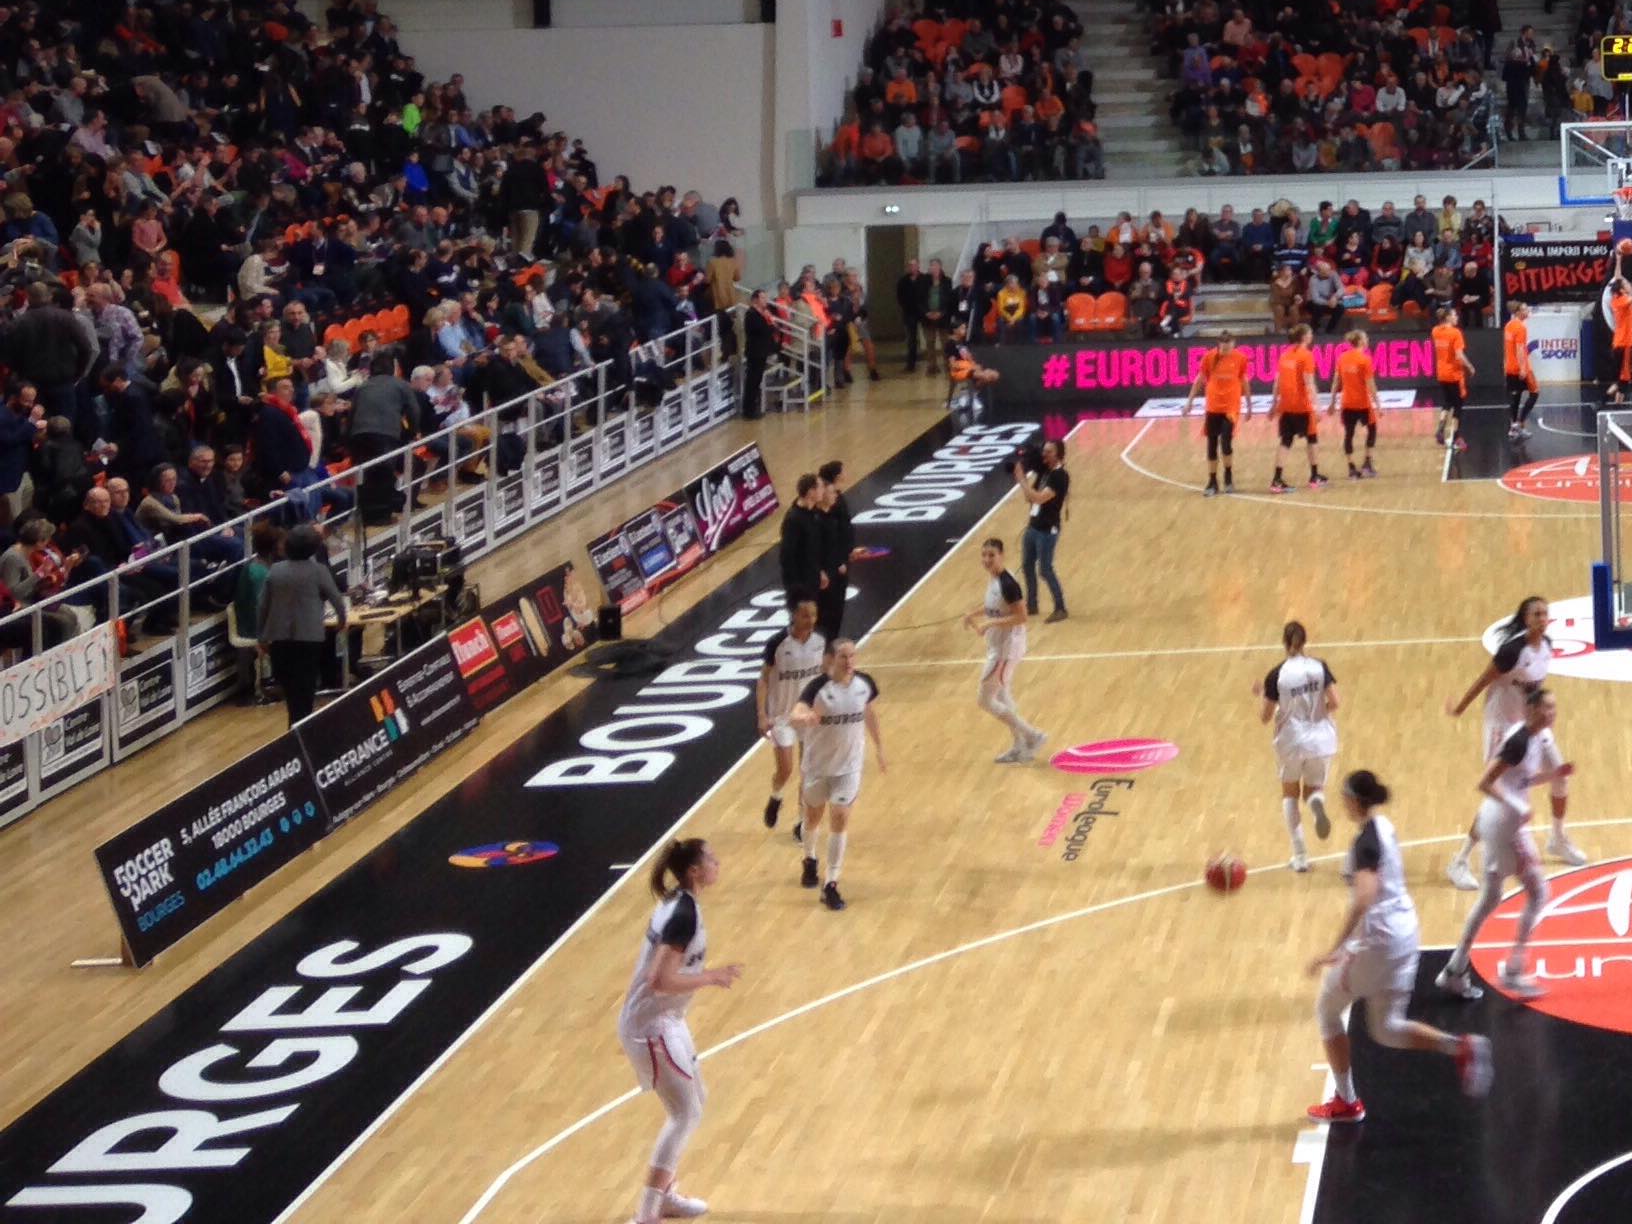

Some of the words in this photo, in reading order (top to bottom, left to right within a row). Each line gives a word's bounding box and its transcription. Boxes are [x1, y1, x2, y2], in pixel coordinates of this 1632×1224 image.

[1510, 246, 1544, 258] SUMMA
[1541, 338, 1578, 350] INTER
[1541, 349, 1577, 360] SPORT
[850, 422, 1042, 524] BOURGES
[266, 757, 302, 794] ARAGO
[316, 728, 391, 788] CERFRANCE
[241, 790, 287, 830] BOURGES
[137, 890, 187, 932] BOURGES
